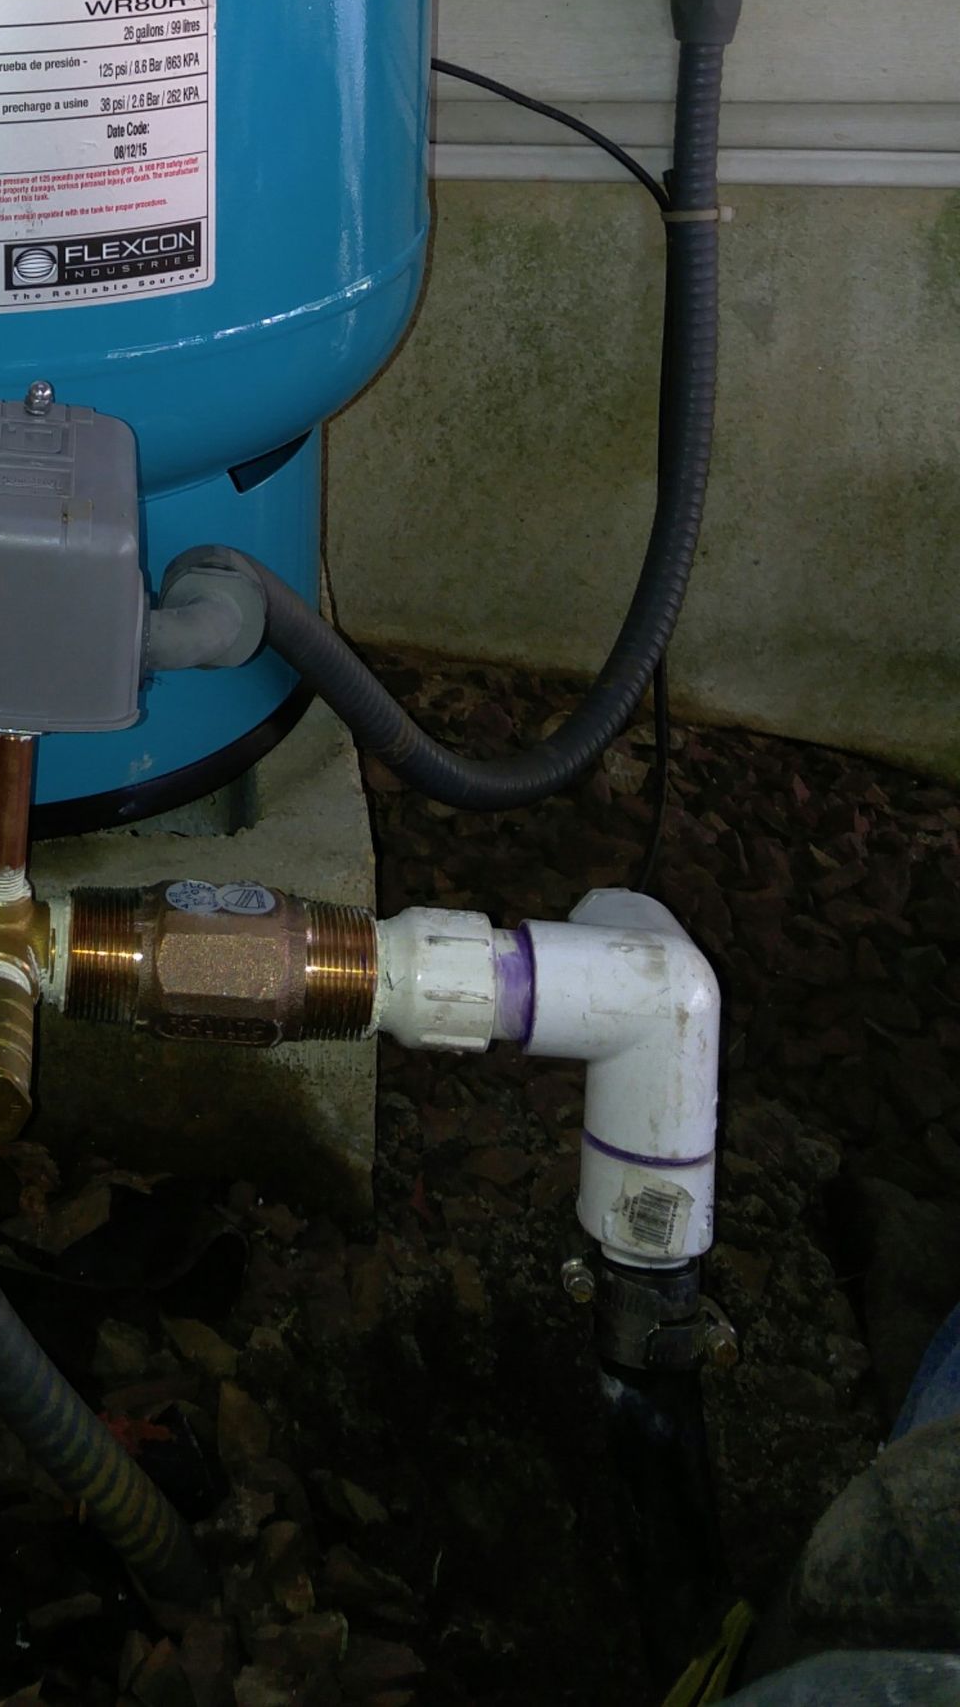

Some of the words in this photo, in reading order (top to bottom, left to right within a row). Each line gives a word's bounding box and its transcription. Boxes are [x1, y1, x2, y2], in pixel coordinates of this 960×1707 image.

[123, 26, 134, 41] 26
[135, 24, 164, 44] gallons
[171, 20, 182, 35] 99
[182, 18, 200, 32] litres
[30, 60, 42, 70] de
[98, 63, 114, 78] 125
[115, 63, 128, 79] psi
[134, 59, 147, 74] 8.6
[148, 58, 163, 72] Bar
[183, 52, 200, 67] KPA
[2, 102, 52, 115] precharge
[63, 98, 89, 109] usine
[100, 98, 111, 112] 38
[112, 97, 126, 114] psi
[132, 94, 145, 108] 2.6
[146, 92, 160, 107] Bar
[166, 89, 181, 104] 262
[183, 86, 200, 101] KPA
[107, 124, 126, 138] Date
[126, 122, 150, 136] Code:
[114, 143, 147, 159] 08/12/15
[64, 230, 195, 263] FLEXCON
[64, 255, 195, 279] INDUSTRIES
[52, 283, 129, 297] Reliable
